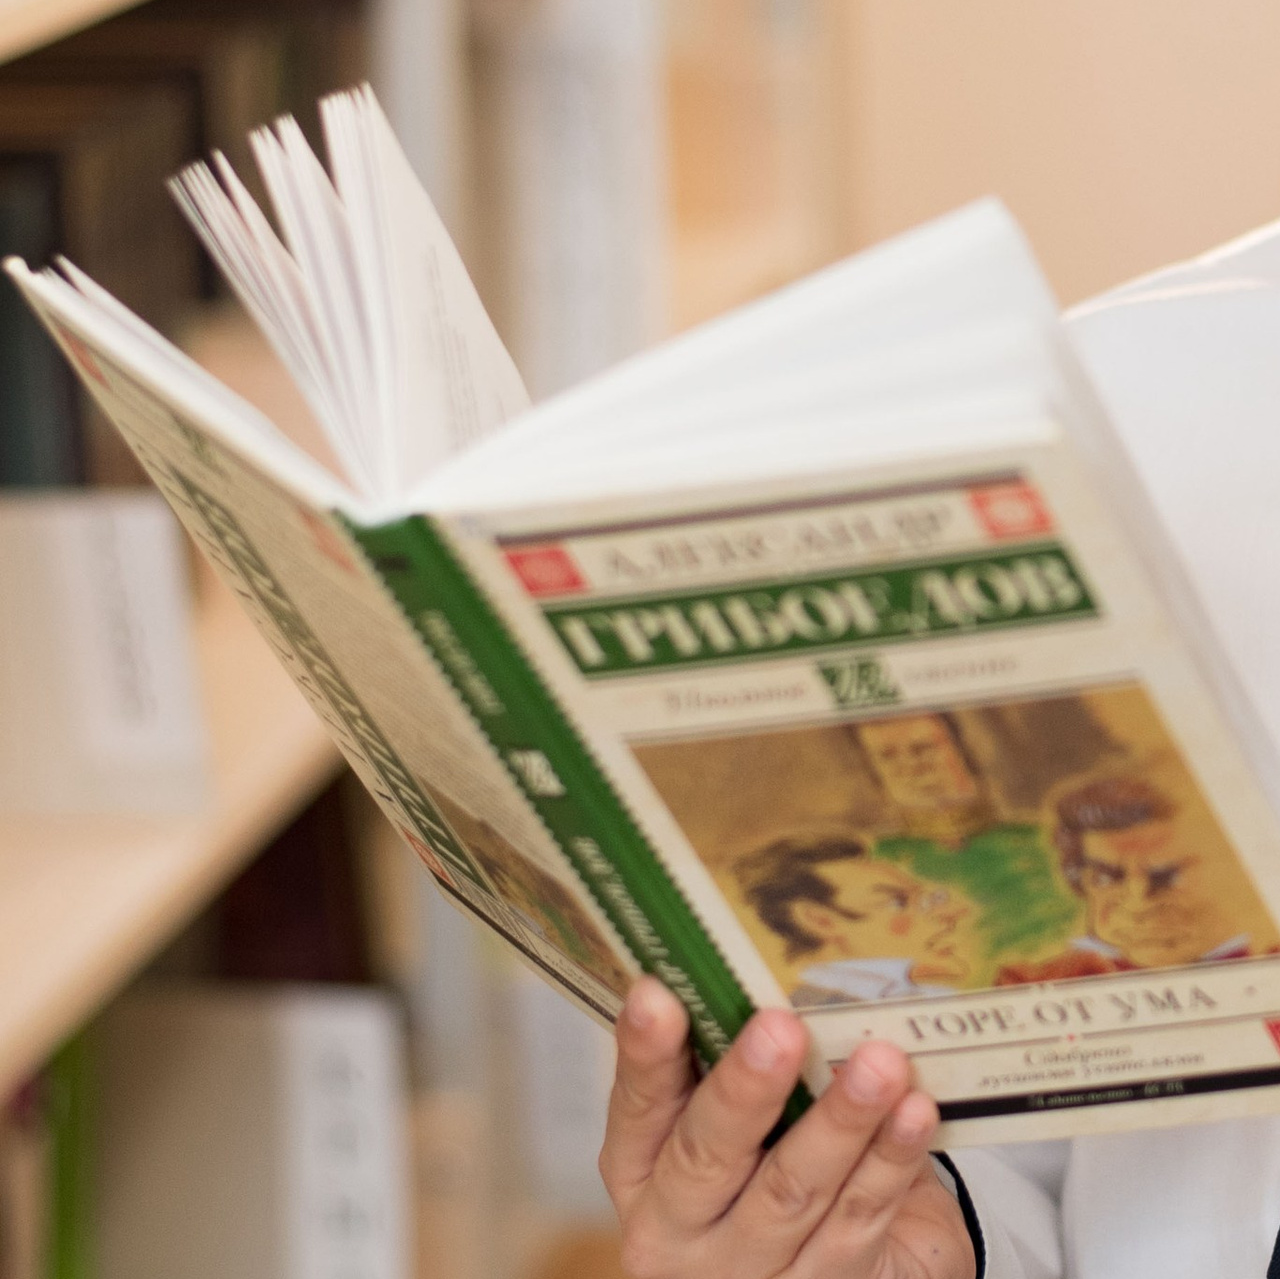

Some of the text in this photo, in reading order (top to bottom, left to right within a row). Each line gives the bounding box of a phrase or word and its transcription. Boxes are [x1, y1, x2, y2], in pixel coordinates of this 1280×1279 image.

[560, 554, 1083, 668] ГРИБОЕДОВ
[907, 983, 1218, 1040] ГОРЕ ОТ УМА
